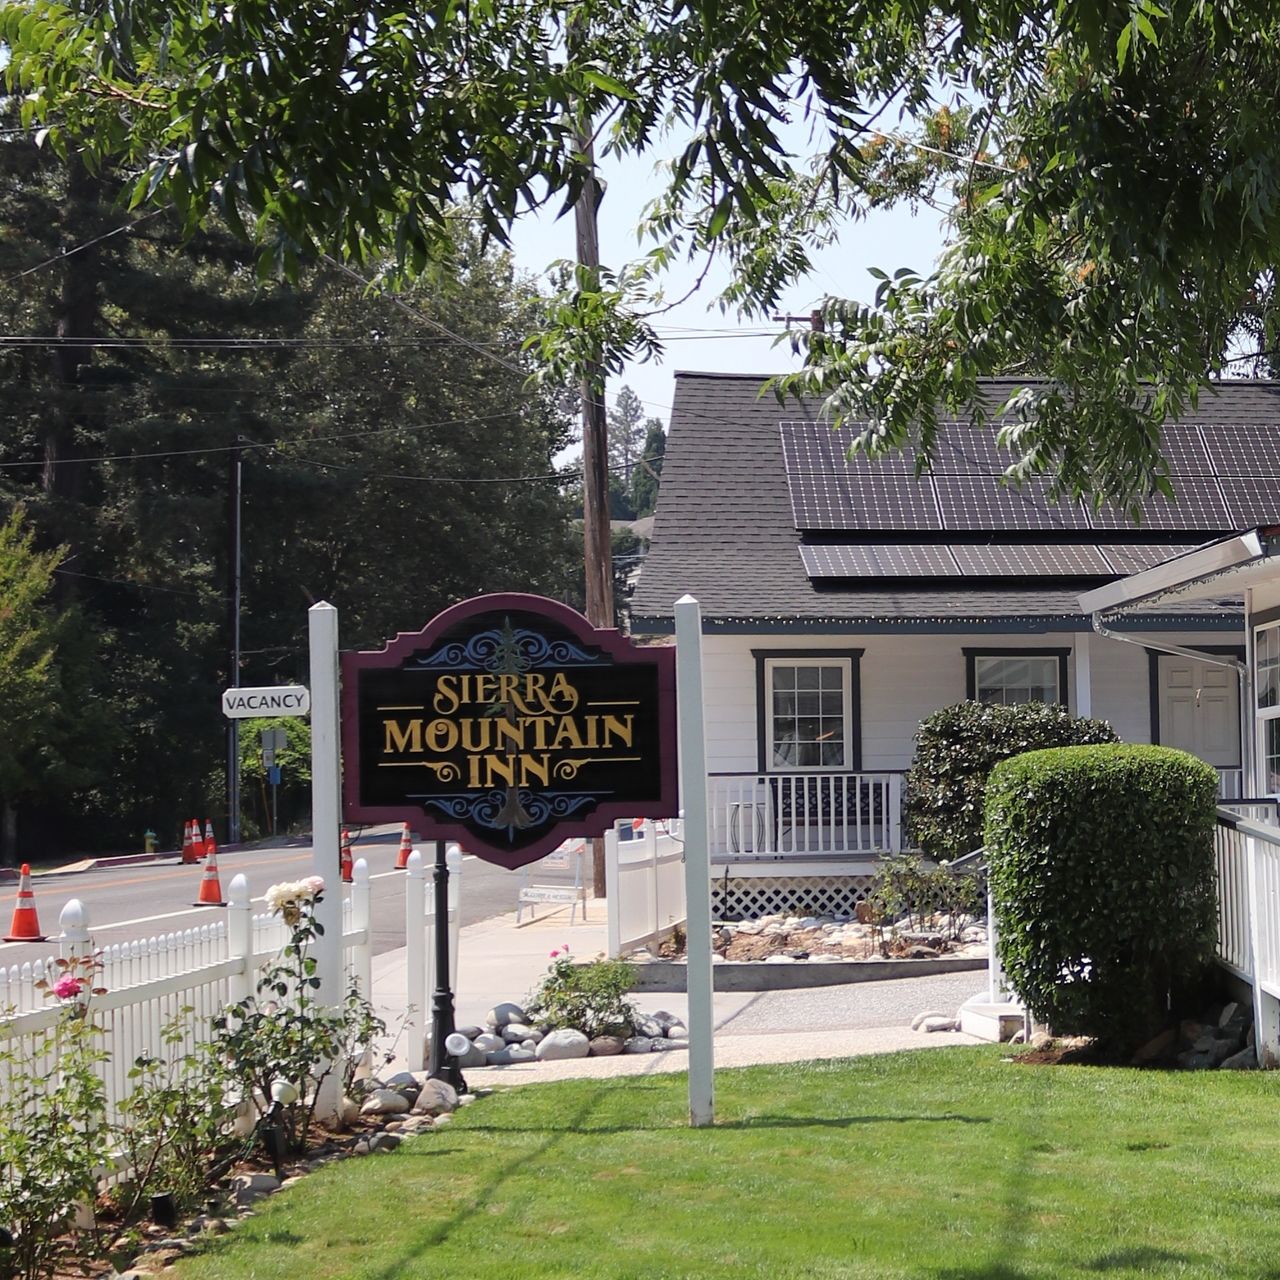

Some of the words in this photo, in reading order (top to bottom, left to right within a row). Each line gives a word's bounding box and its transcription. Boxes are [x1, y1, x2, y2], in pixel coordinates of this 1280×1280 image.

[225, 694, 304, 710] VACANCY
[433, 672, 579, 715] SIERRA
[383, 714, 635, 754] MOUNTAIN
[467, 753, 551, 788] INN
